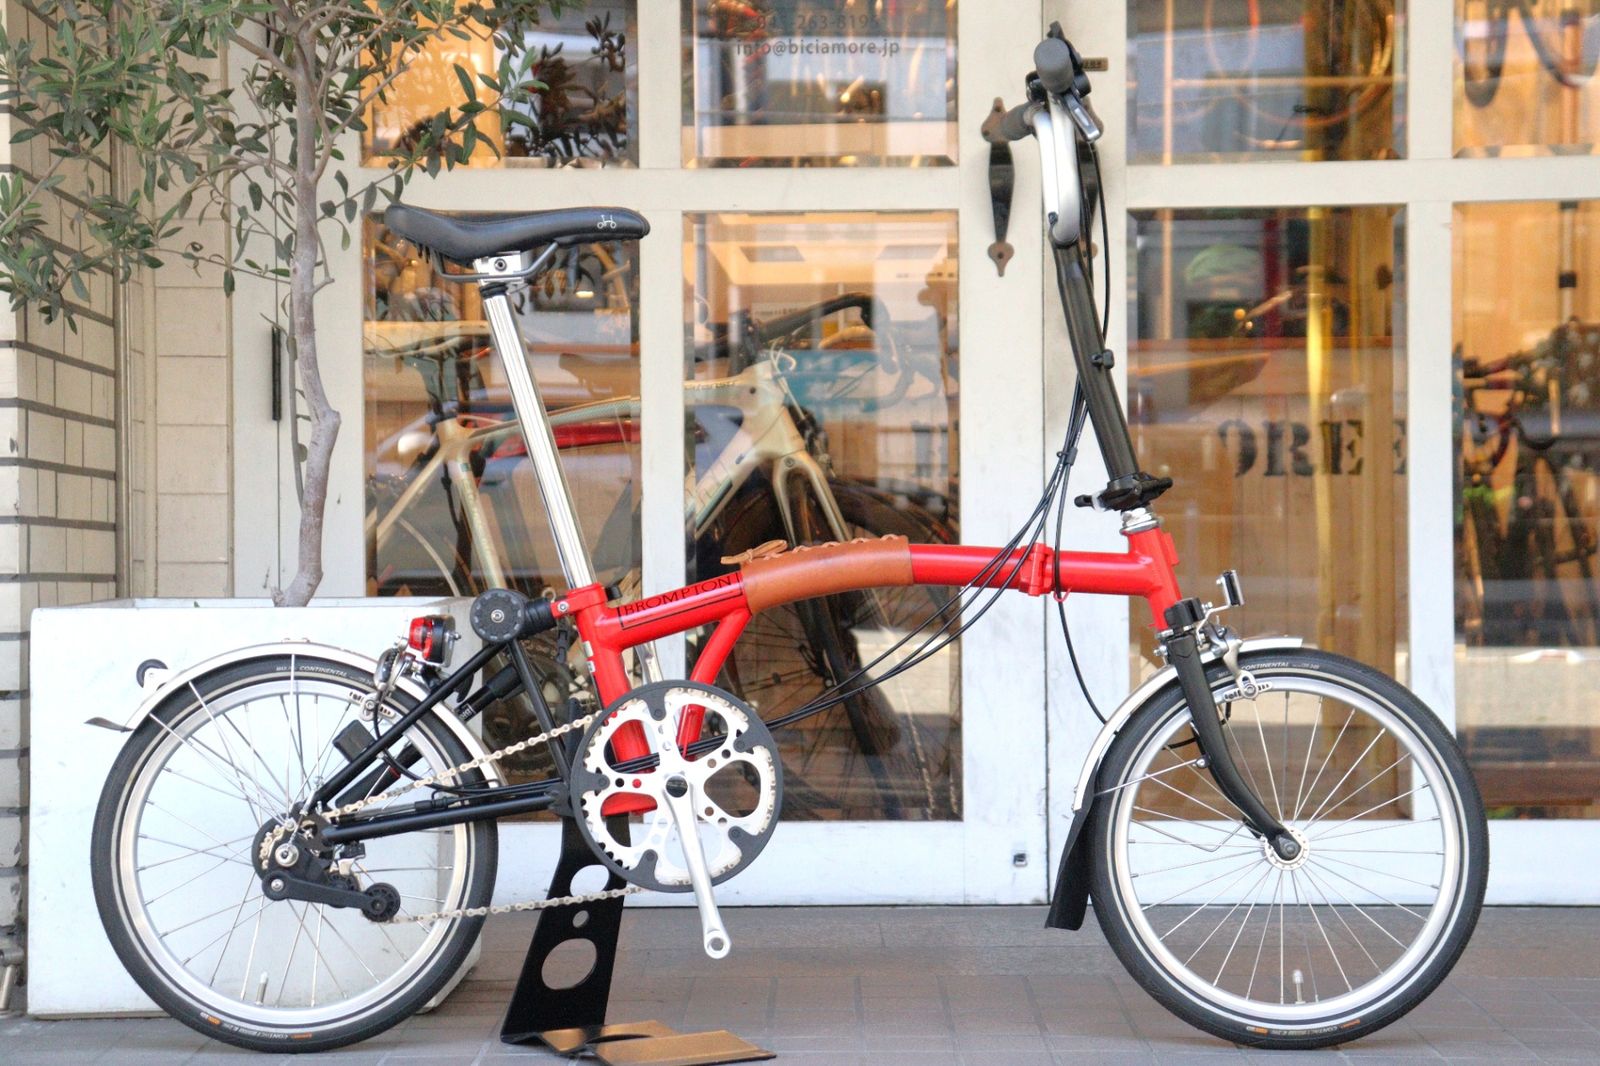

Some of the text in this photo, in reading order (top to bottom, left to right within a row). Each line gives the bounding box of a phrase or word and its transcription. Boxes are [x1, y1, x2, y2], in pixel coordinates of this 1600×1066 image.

[736, 38, 900, 57] info@biciamore.jp
[624, 576, 731, 616] BROMPTON
[299, 665, 348, 678] CONTINENTAL
